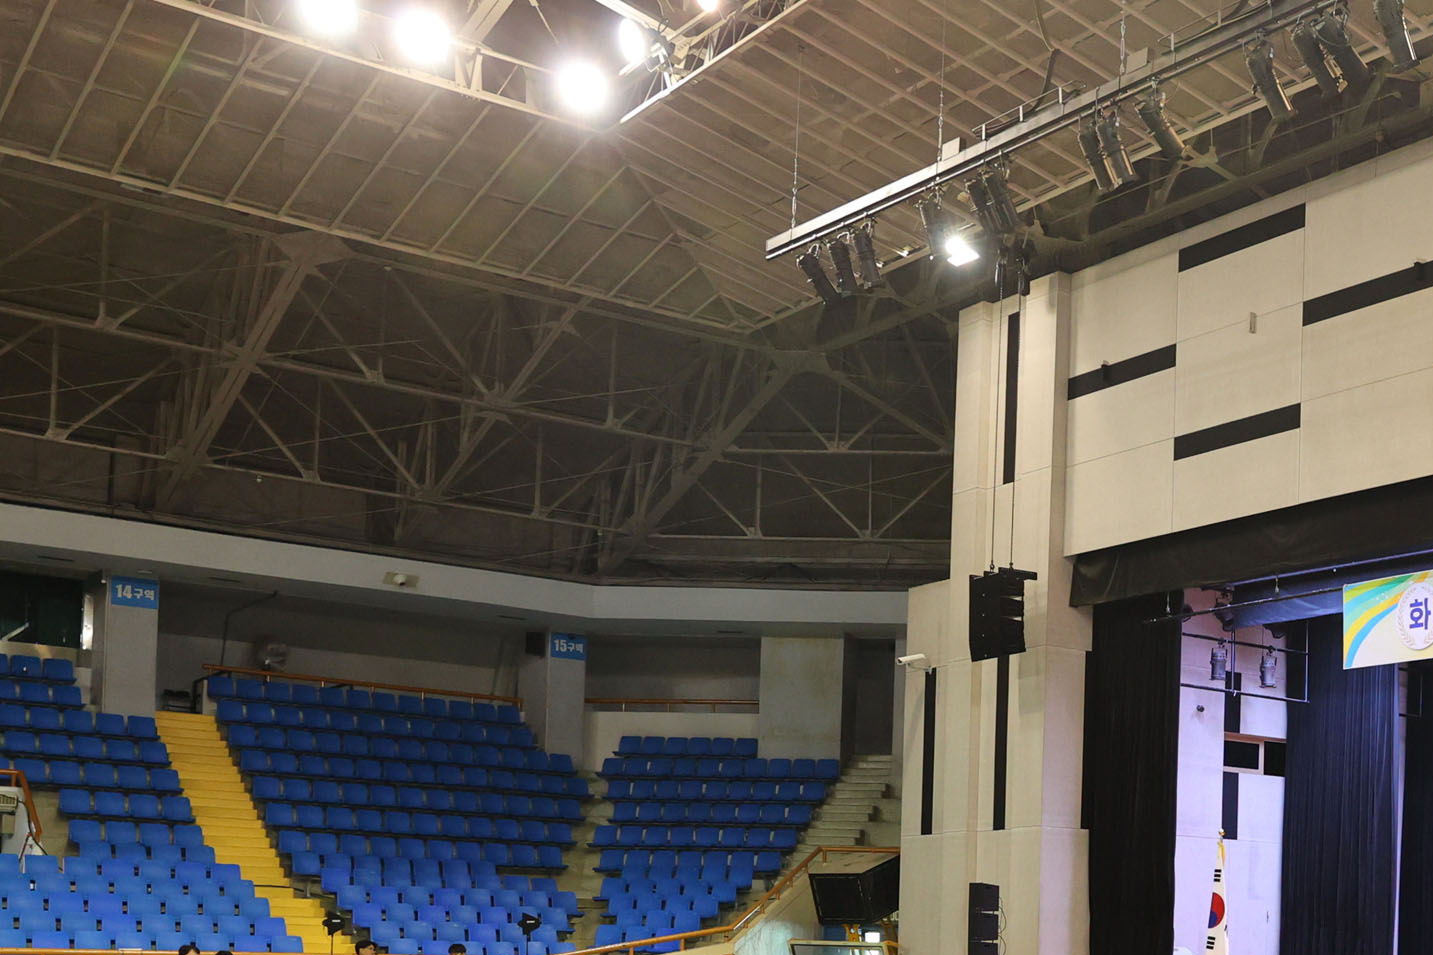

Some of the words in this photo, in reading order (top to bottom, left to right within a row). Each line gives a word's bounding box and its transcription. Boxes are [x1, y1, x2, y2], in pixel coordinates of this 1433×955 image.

[115, 584, 155, 601] 14구역
[1408, 597, 1432, 630] 화
[553, 639, 584, 654] 15구역
